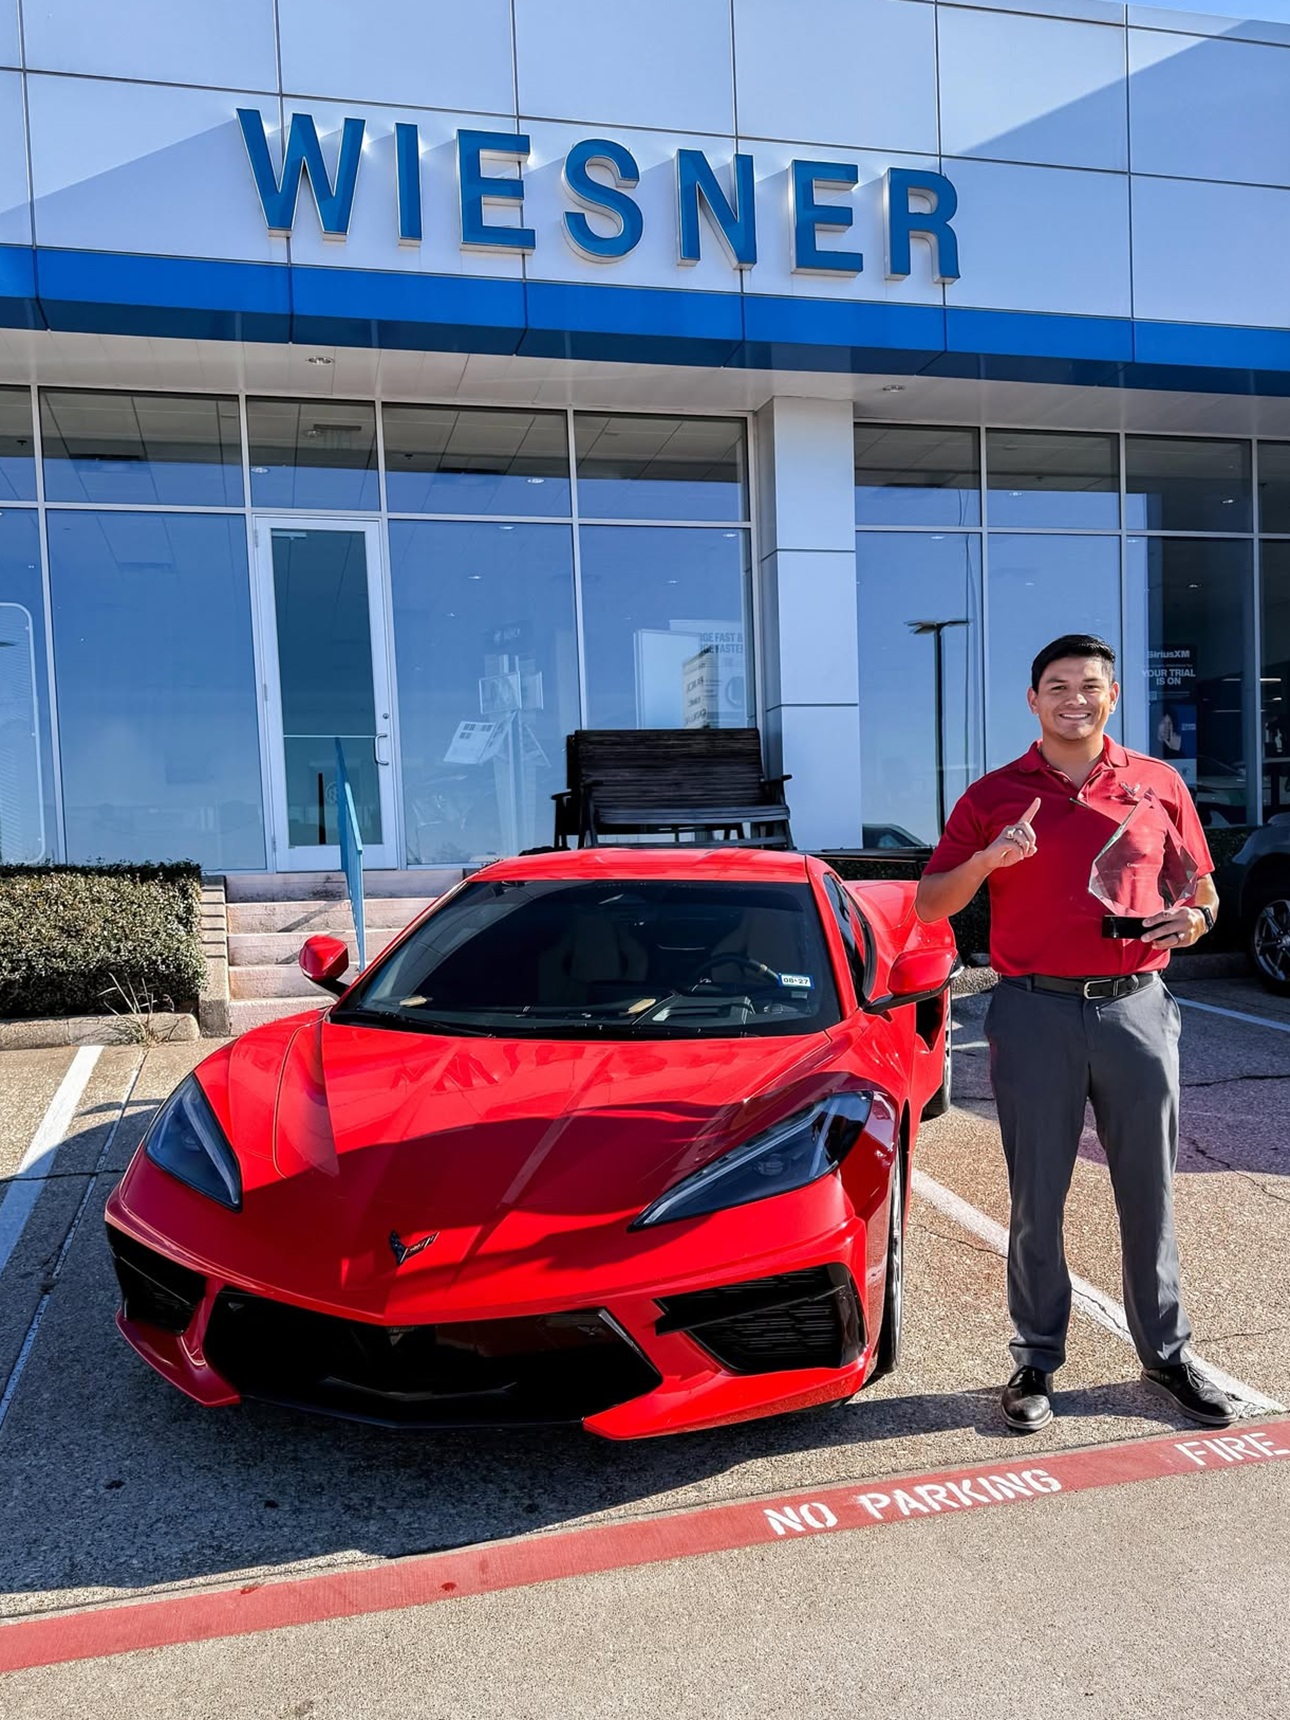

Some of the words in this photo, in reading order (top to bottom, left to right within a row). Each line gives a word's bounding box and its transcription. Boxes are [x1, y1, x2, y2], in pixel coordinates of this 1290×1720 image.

[235, 107, 961, 284] WIESNER
[715, 632, 735, 643] FAST
[1147, 649, 1190, 659] SiriusXM
[1141, 668, 1167, 677] YOUR
[1169, 668, 1196, 677] TRIAL
[1156, 677, 1165, 685] IS
[1167, 677, 1181, 685] ON
[763, 1502, 838, 1535] NO
[855, 1468, 1062, 1520] PARKING
[1174, 1432, 1290, 1466] FIRE
